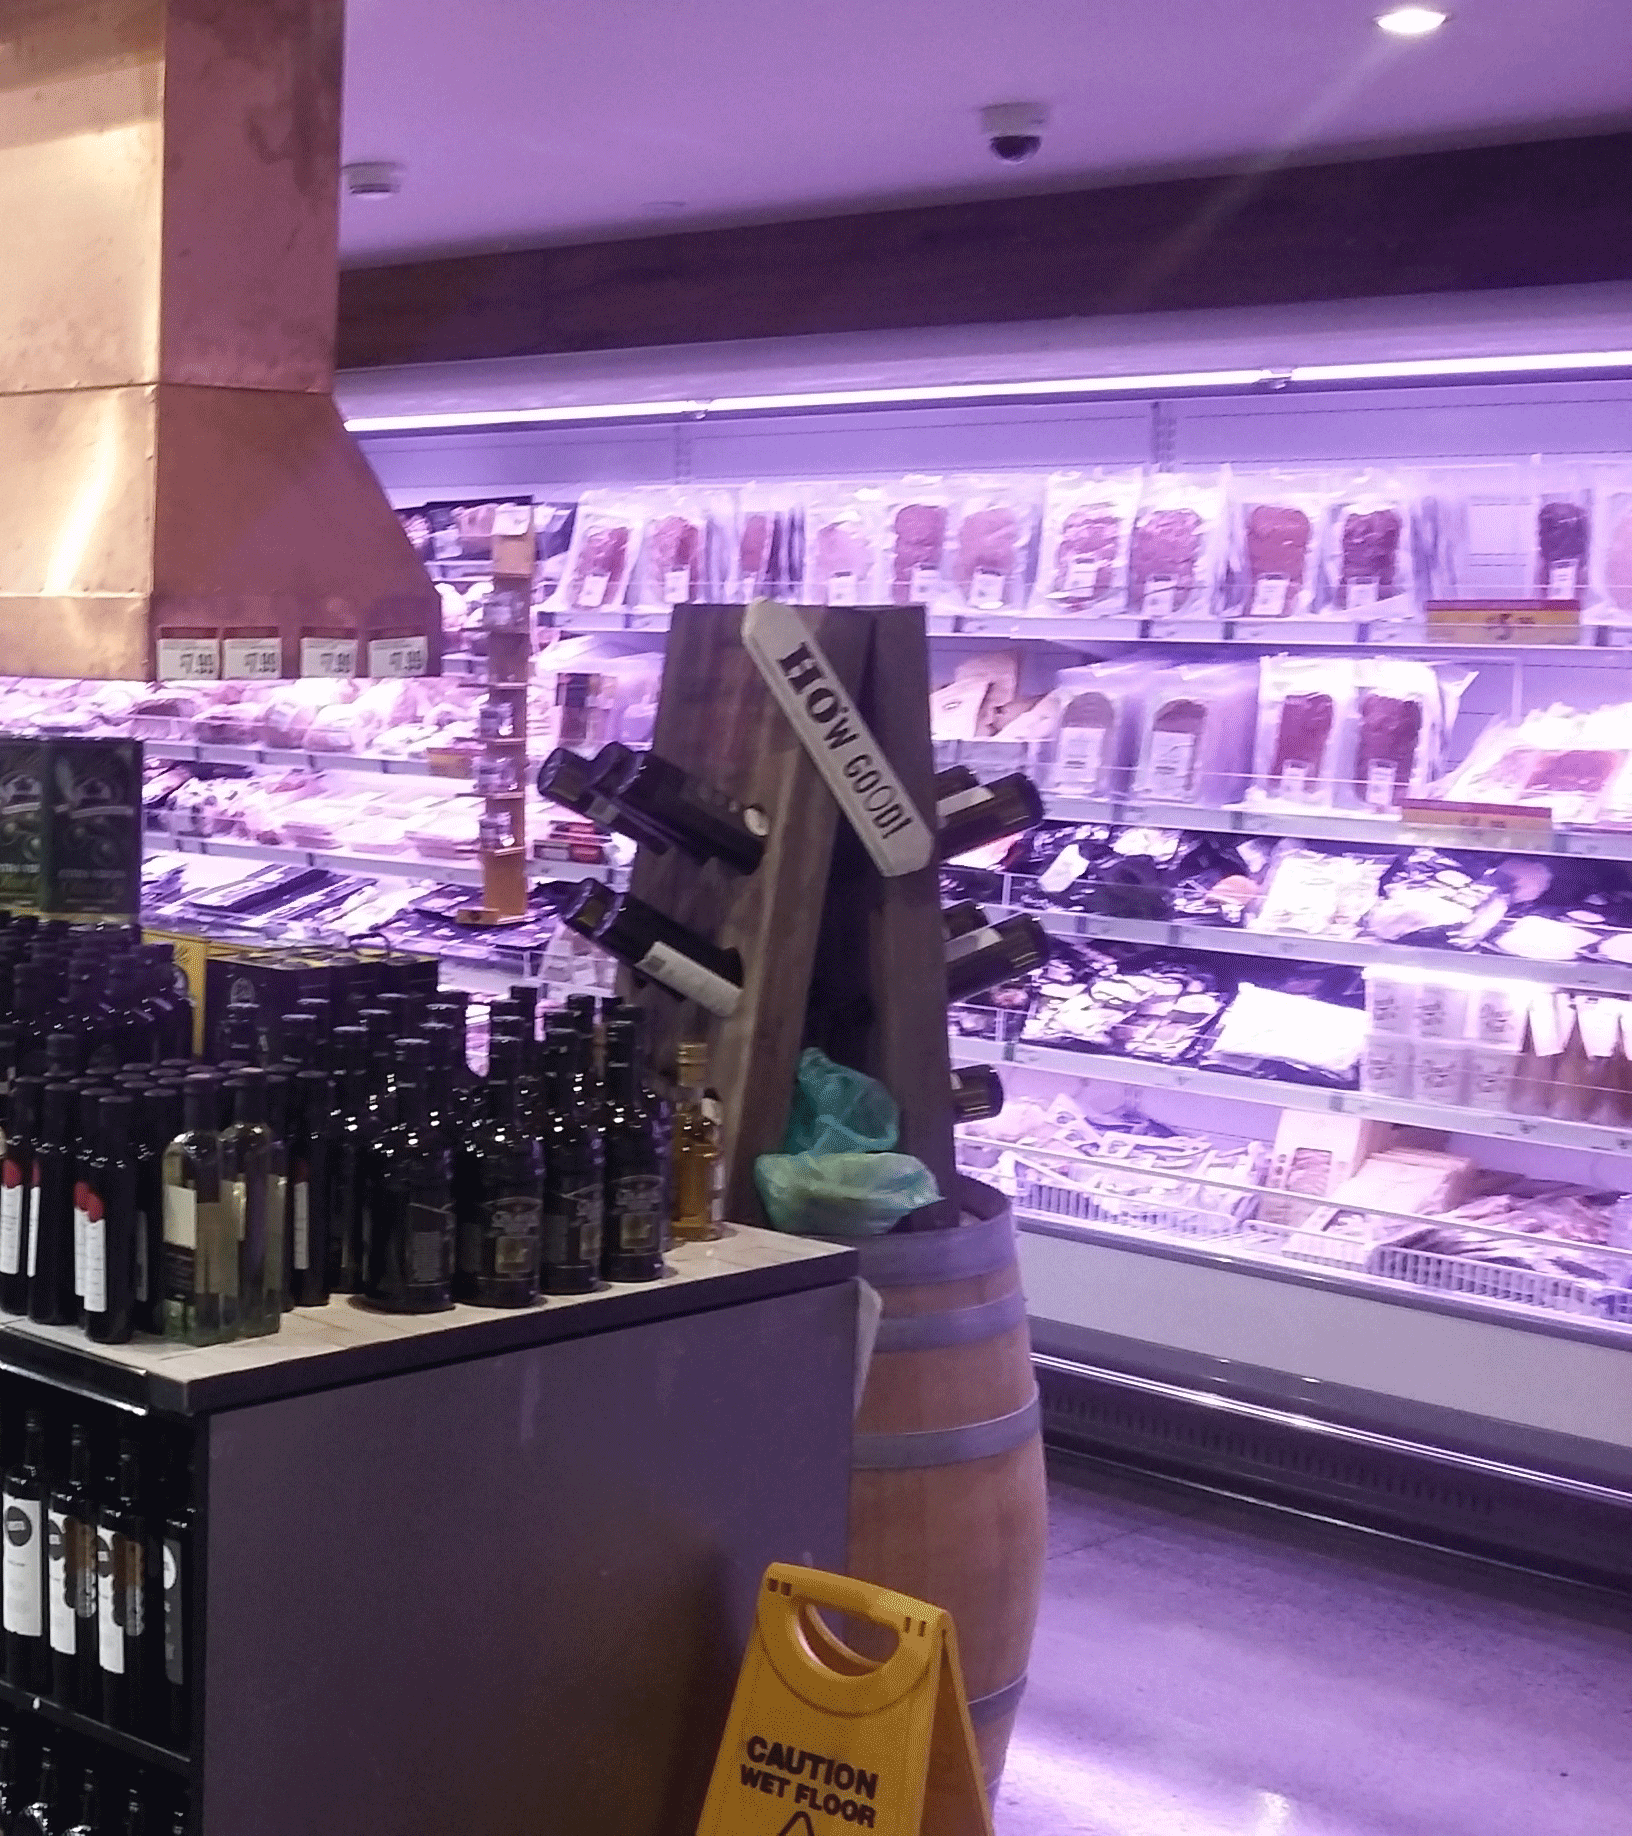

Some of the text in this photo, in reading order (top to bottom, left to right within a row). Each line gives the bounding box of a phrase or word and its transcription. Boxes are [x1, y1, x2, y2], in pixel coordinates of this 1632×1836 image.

[778, 641, 858, 750] HOW
[739, 1763, 877, 1828] WET FLOOR
[746, 1735, 879, 1800] CAUTION
